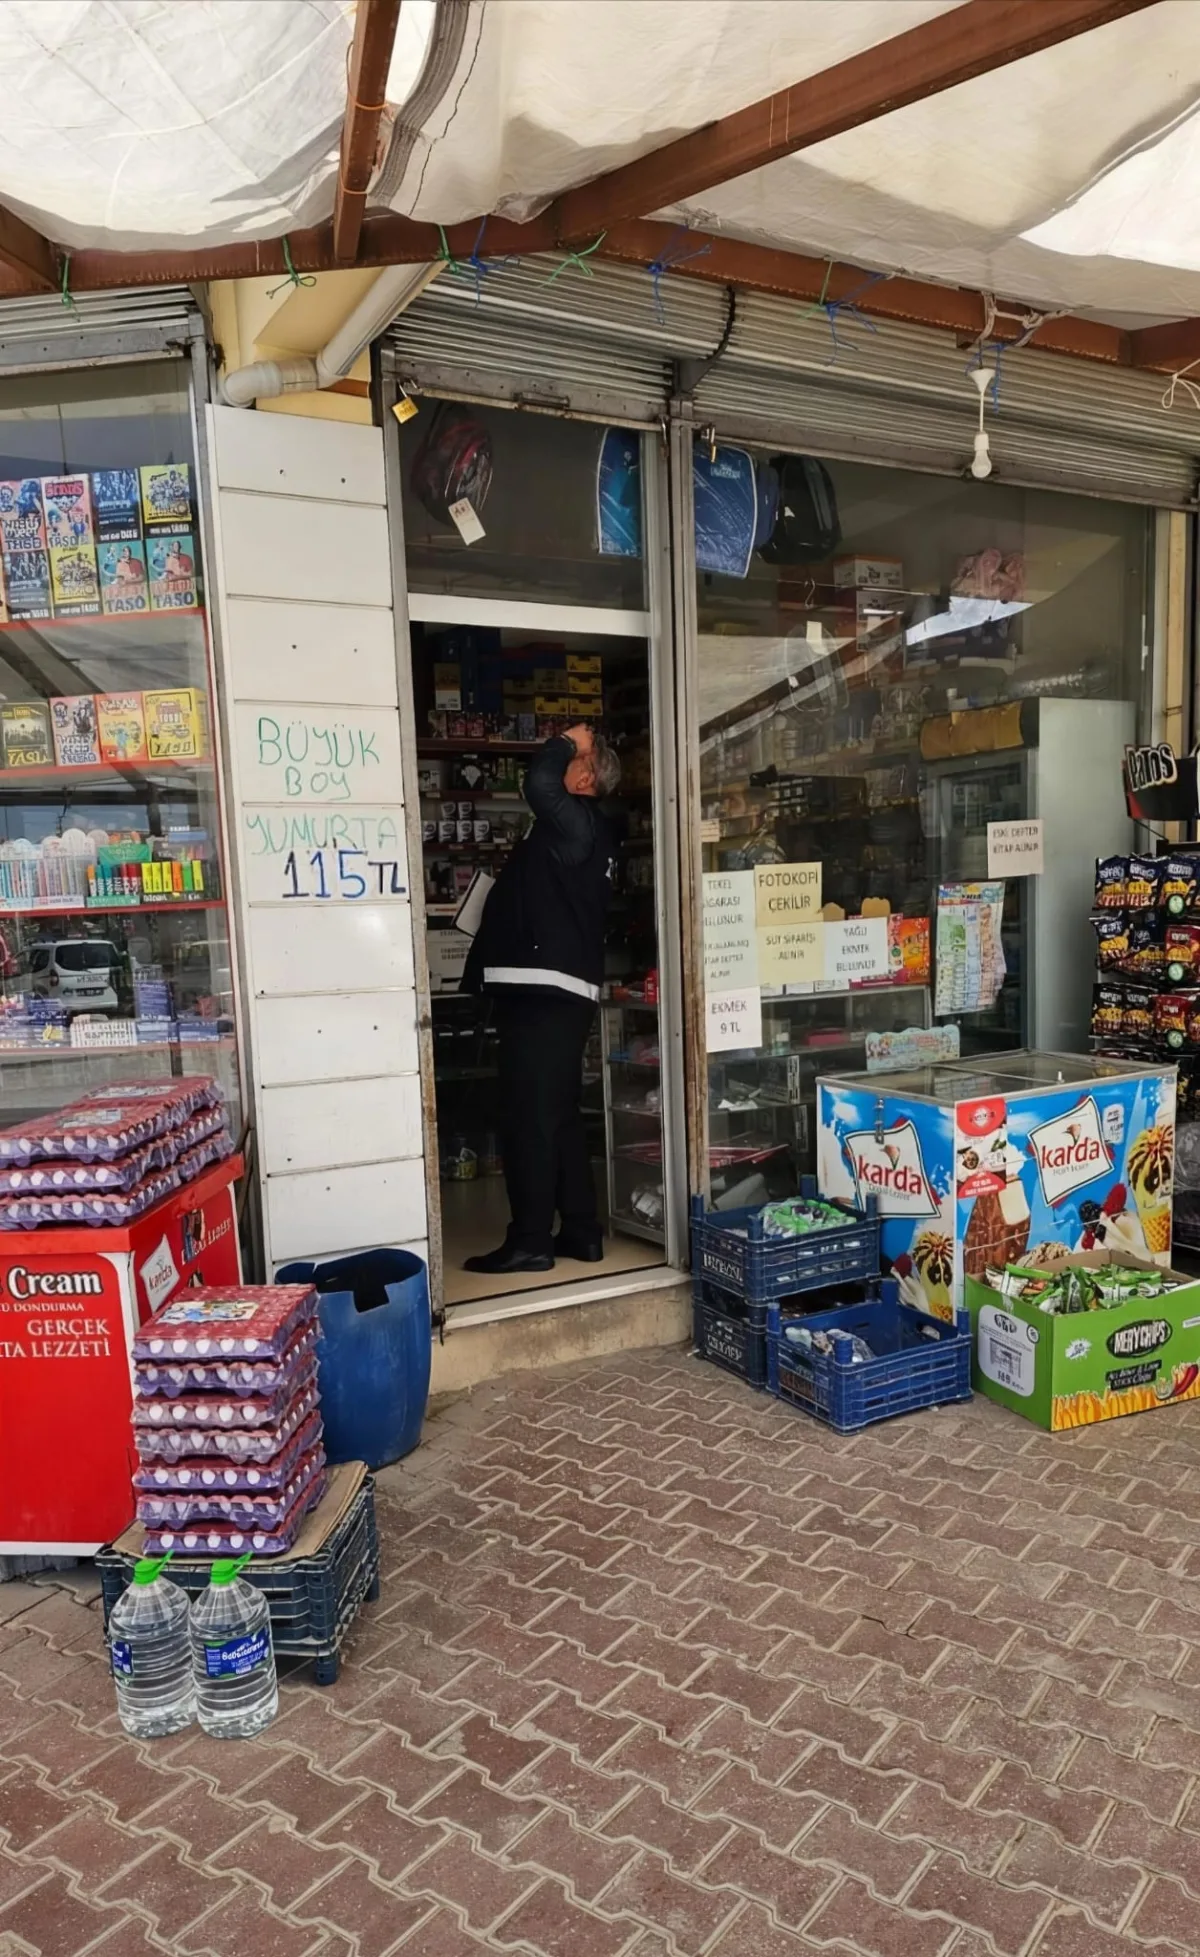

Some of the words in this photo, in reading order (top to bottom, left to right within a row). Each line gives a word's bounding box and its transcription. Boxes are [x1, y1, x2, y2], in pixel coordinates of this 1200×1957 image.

[105, 596, 146, 613] TASO
[152, 591, 194, 608] TASO
[258, 716, 380, 768] BÜYÜK
[285, 766, 351, 801] BOY
[246, 813, 398, 856] YUMURTA
[759, 868, 818, 887] FOTOKOPİ
[768, 893, 811, 913] ÇEKİLİR
[711, 1000, 748, 1015] EKMEK
[720, 1022, 727, 1034] 9
[729, 1021, 741, 1033] TL
[1040, 1136, 1101, 1170] karda
[858, 1154, 922, 1196] karda
[8, 1266, 103, 1300] Cream
[13, 1302, 85, 1313] DONDURMA
[27, 1318, 112, 1340] GERÇEK
[31, 1336, 111, 1358] LEZZETİ
